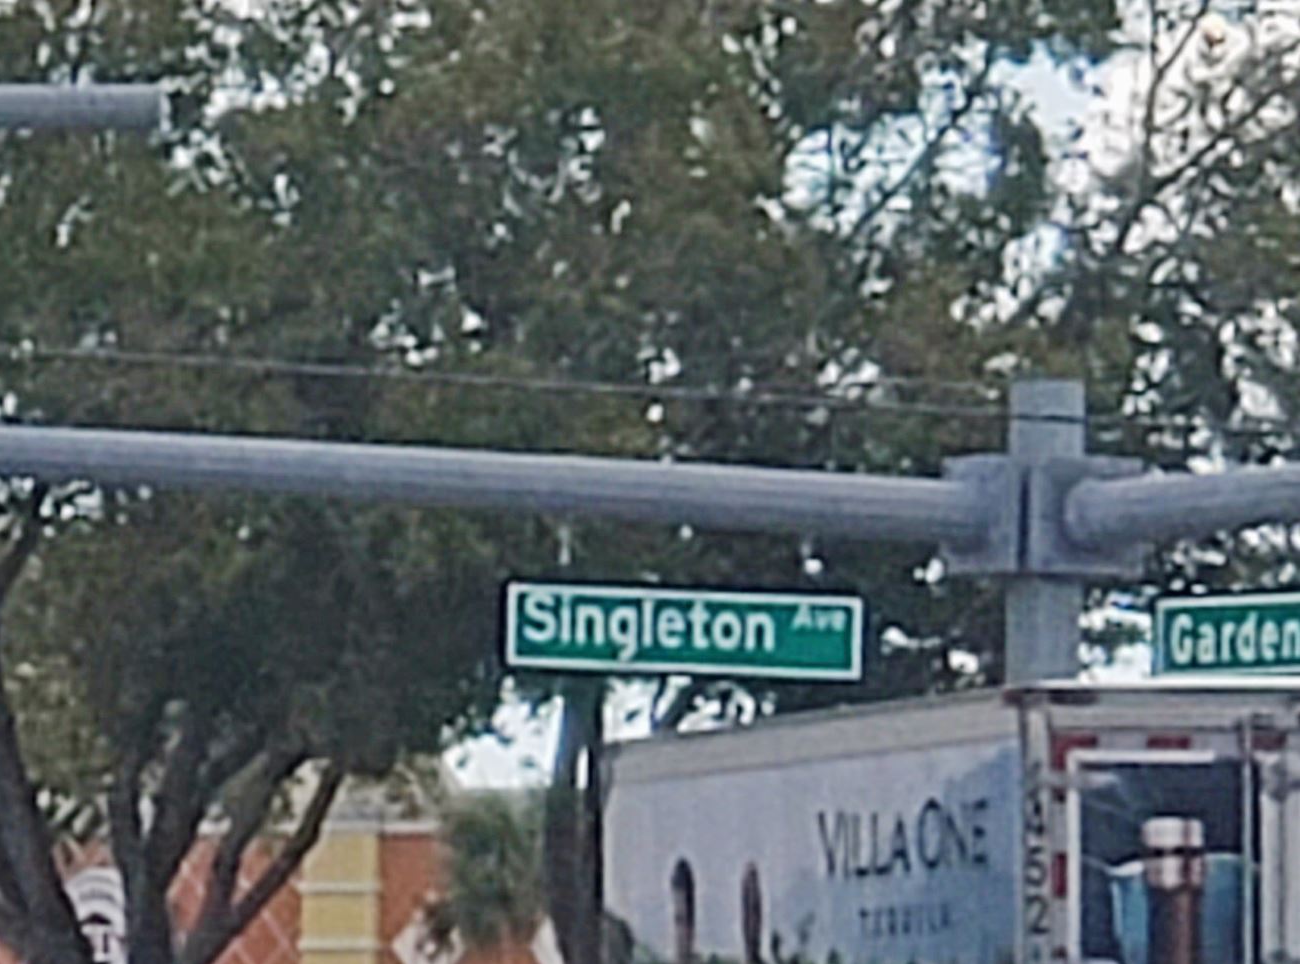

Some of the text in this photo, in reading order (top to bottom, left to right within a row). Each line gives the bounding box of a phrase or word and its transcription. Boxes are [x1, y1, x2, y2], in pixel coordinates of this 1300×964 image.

[522, 591, 848, 662] Singleton Ave
[1170, 609, 1300, 665] Garden
[817, 797, 988, 880] VILLA ONE
